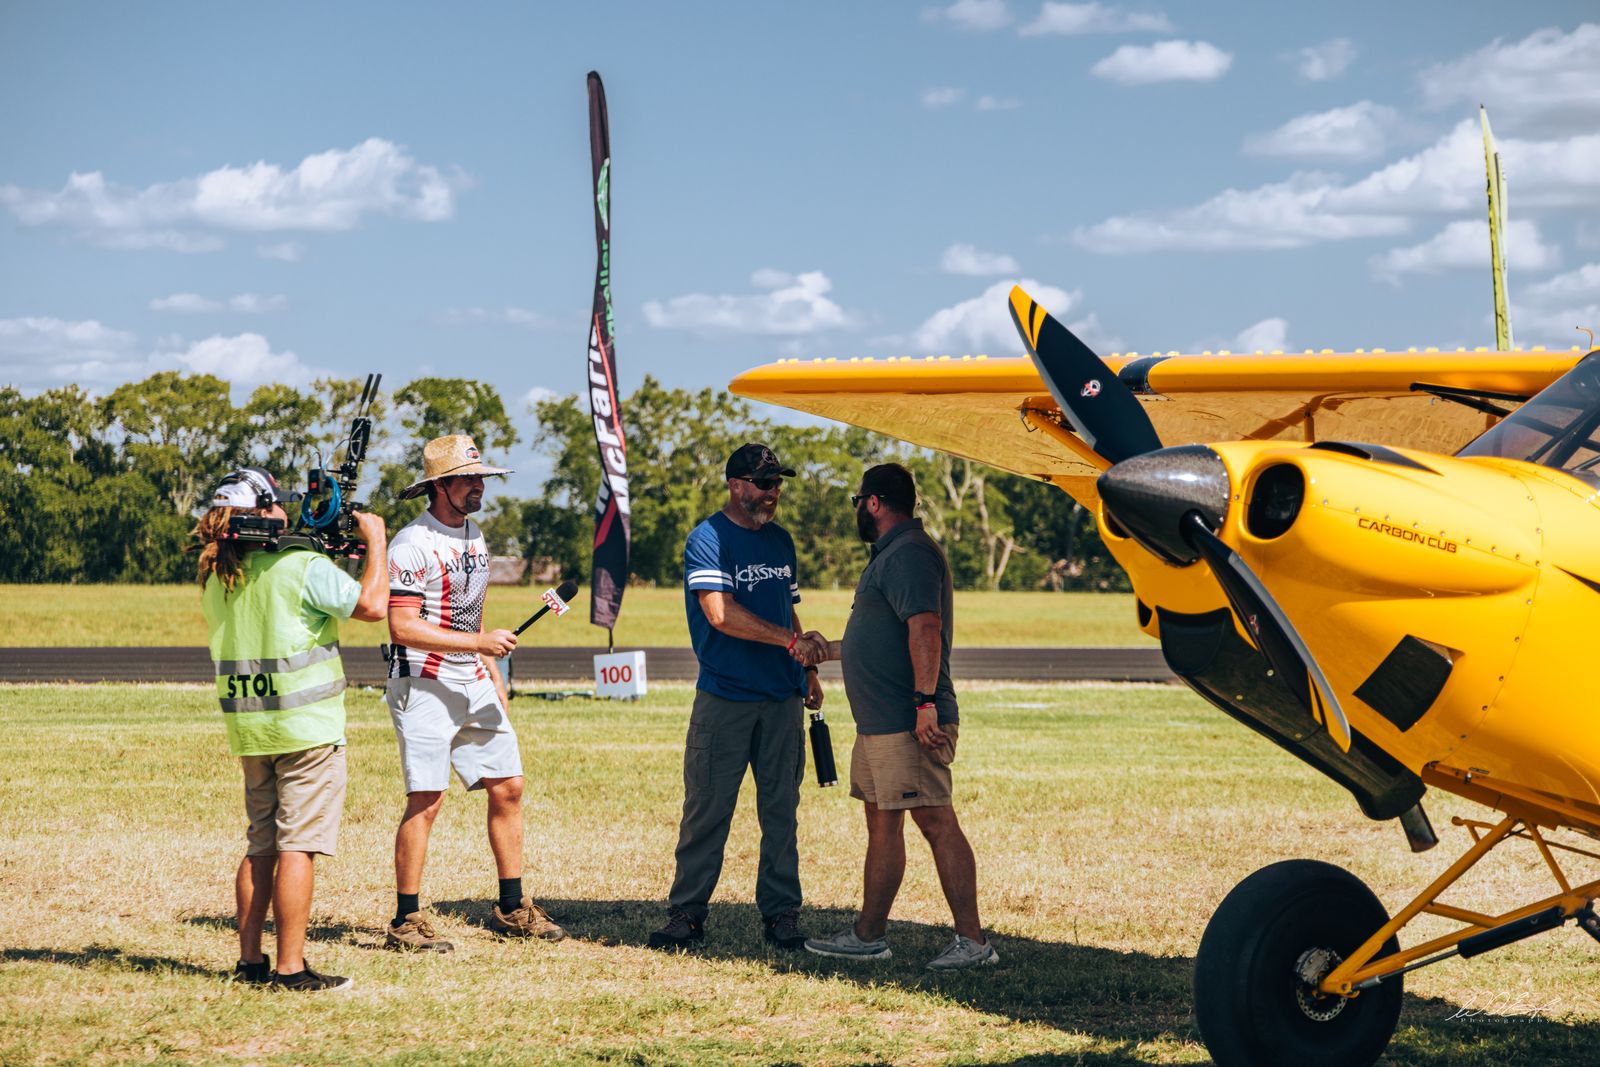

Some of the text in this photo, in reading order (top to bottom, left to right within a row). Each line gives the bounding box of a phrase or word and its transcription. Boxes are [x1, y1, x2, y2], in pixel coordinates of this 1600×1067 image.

[1358, 518, 1457, 553] CARBON CUB
[228, 673, 278, 698] STOL
[600, 665, 632, 684] 100
